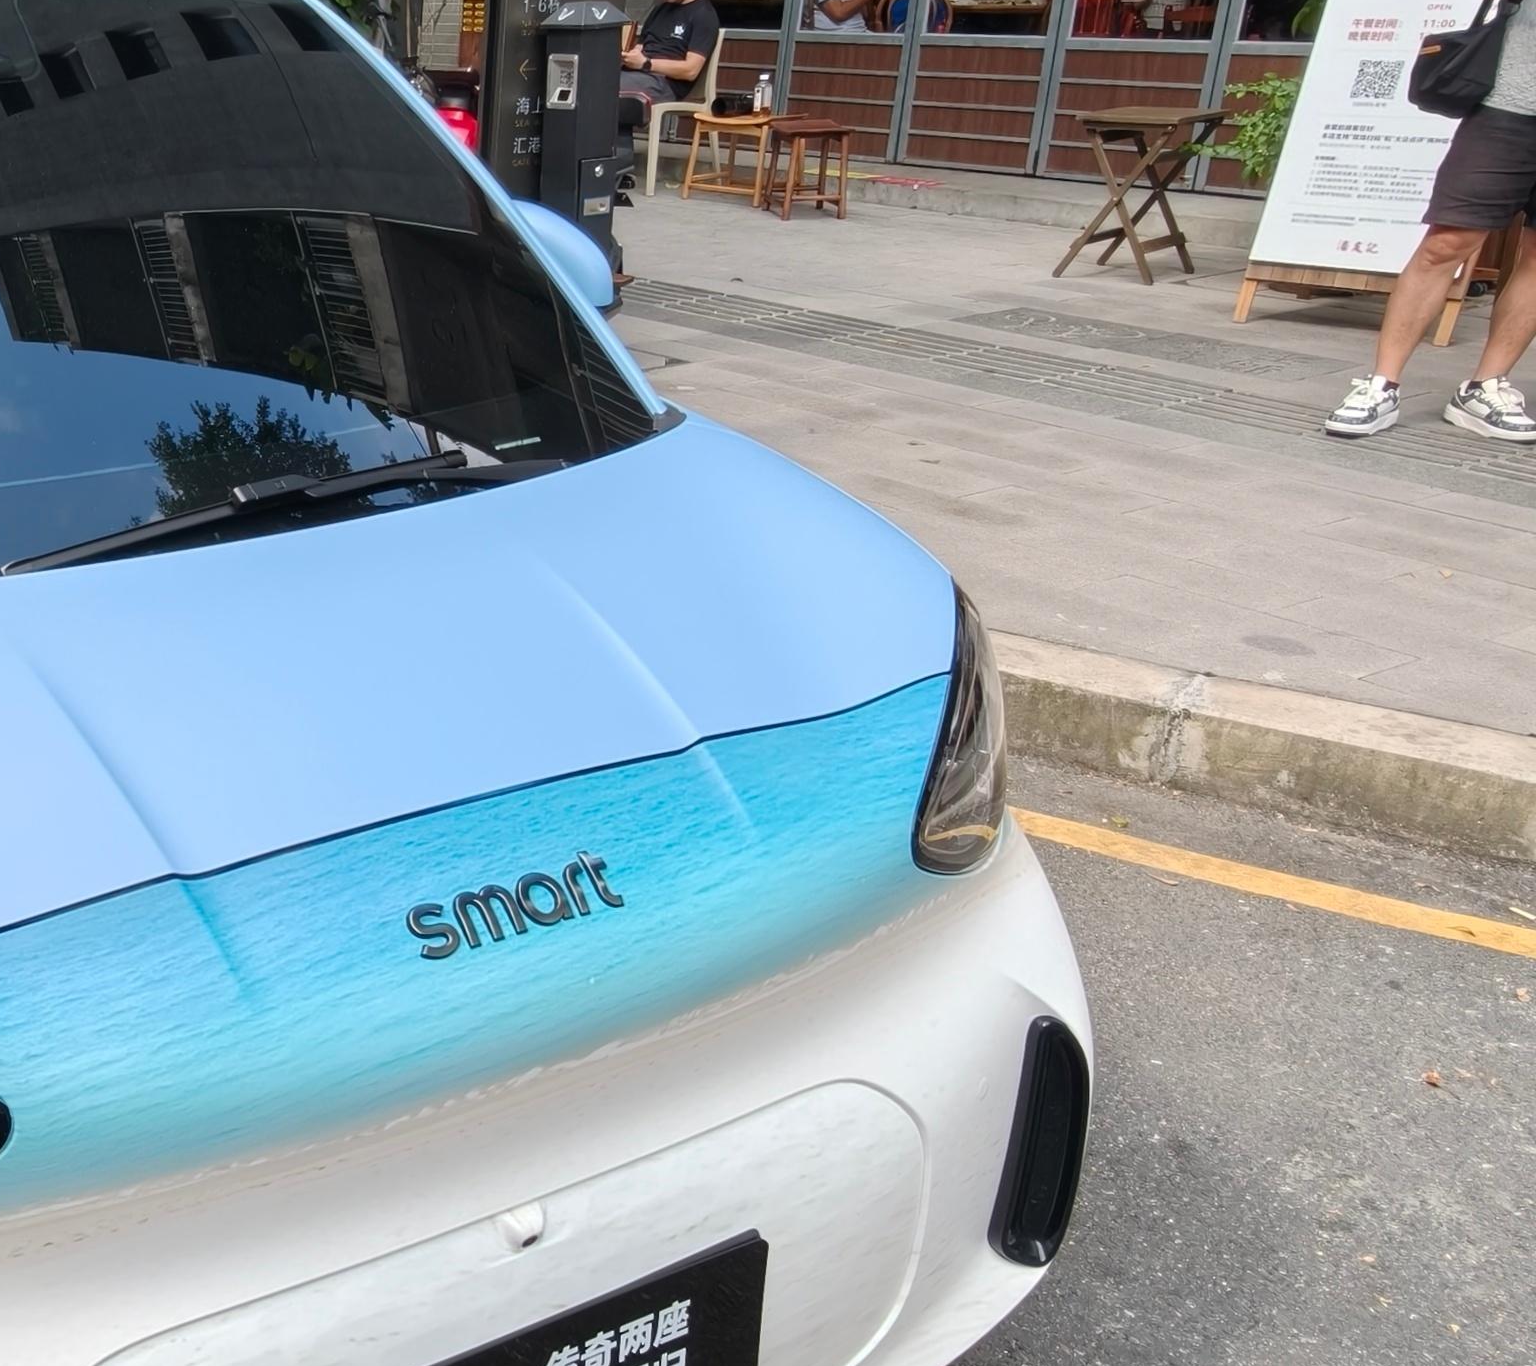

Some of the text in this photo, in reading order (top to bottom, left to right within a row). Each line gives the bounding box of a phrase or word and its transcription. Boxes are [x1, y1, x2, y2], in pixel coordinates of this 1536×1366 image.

[1427, 3, 1453, 11] OPEN
[1422, 19, 1456, 28] 11:00
[405, 850, 625, 961] smart
